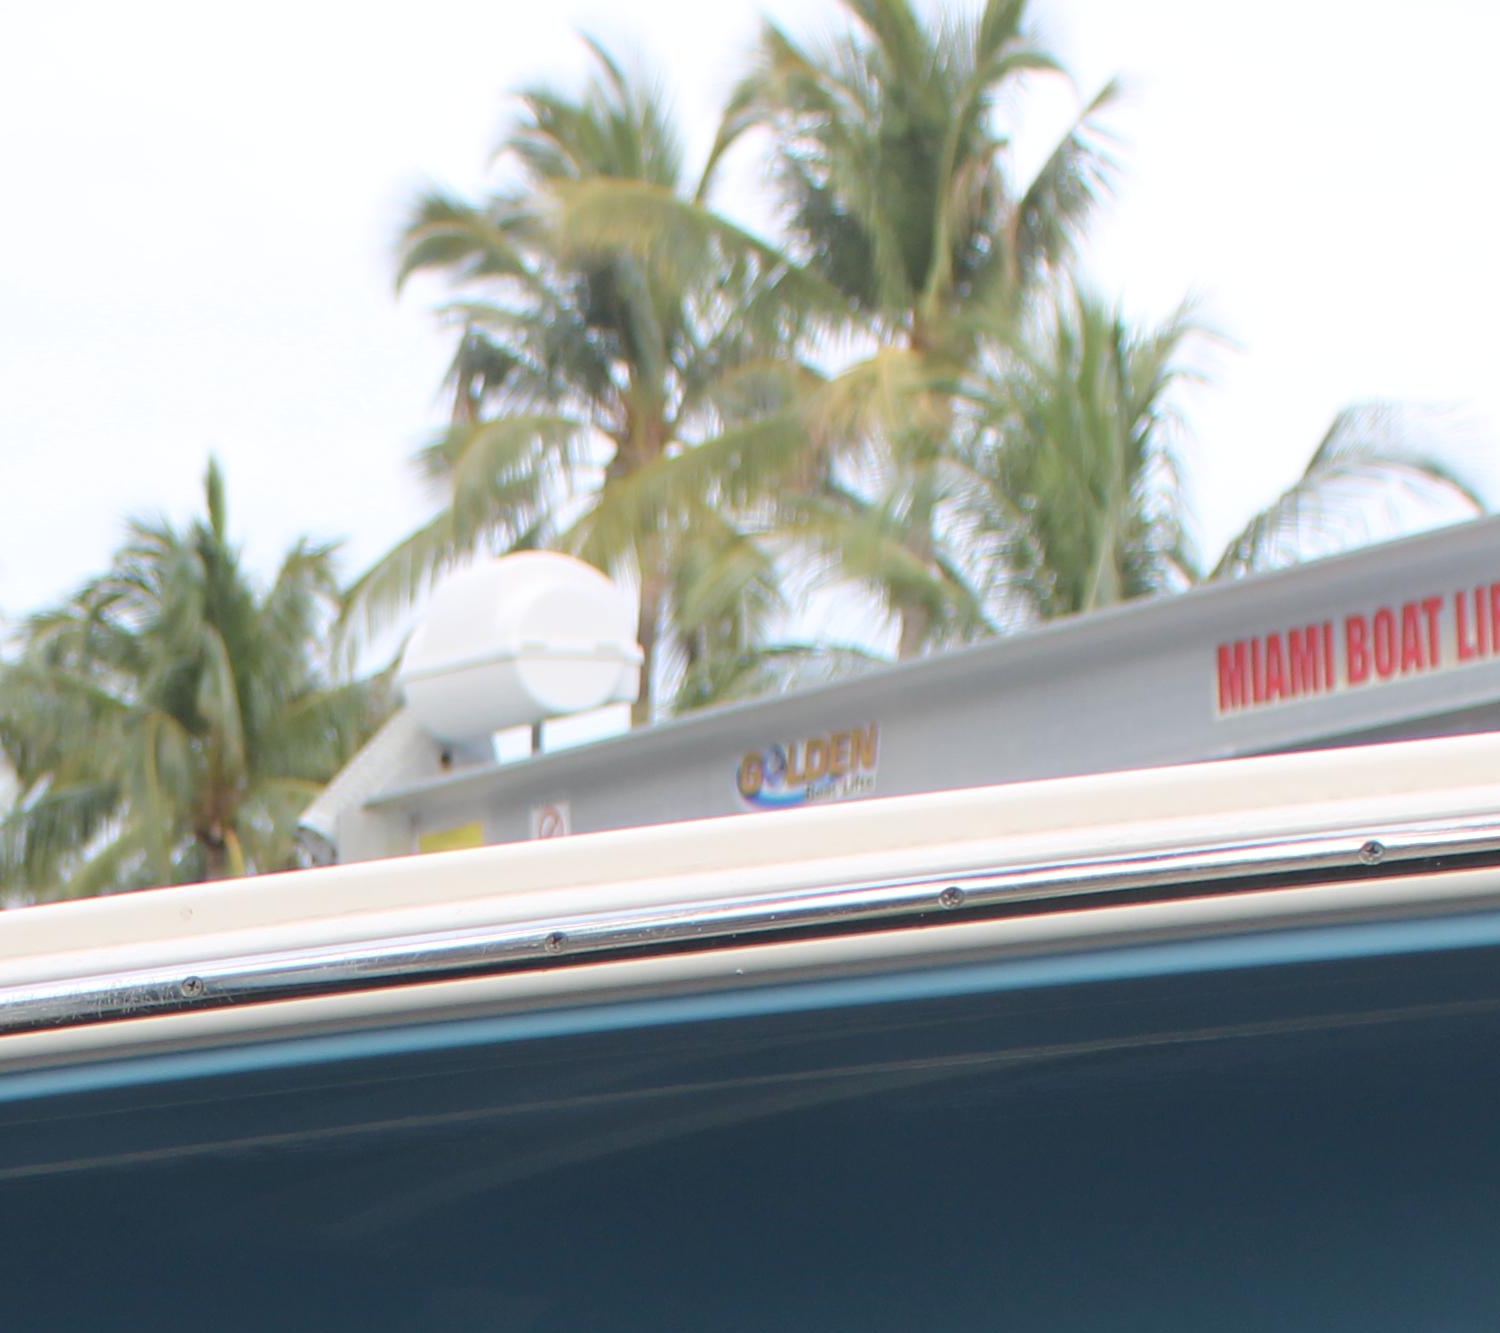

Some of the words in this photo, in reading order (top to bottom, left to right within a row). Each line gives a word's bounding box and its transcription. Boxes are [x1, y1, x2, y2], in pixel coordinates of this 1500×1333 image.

[1216, 620, 1335, 715] MIAMI
[1344, 596, 1444, 686] BOAT
[738, 721, 878, 798] GOLDEN
